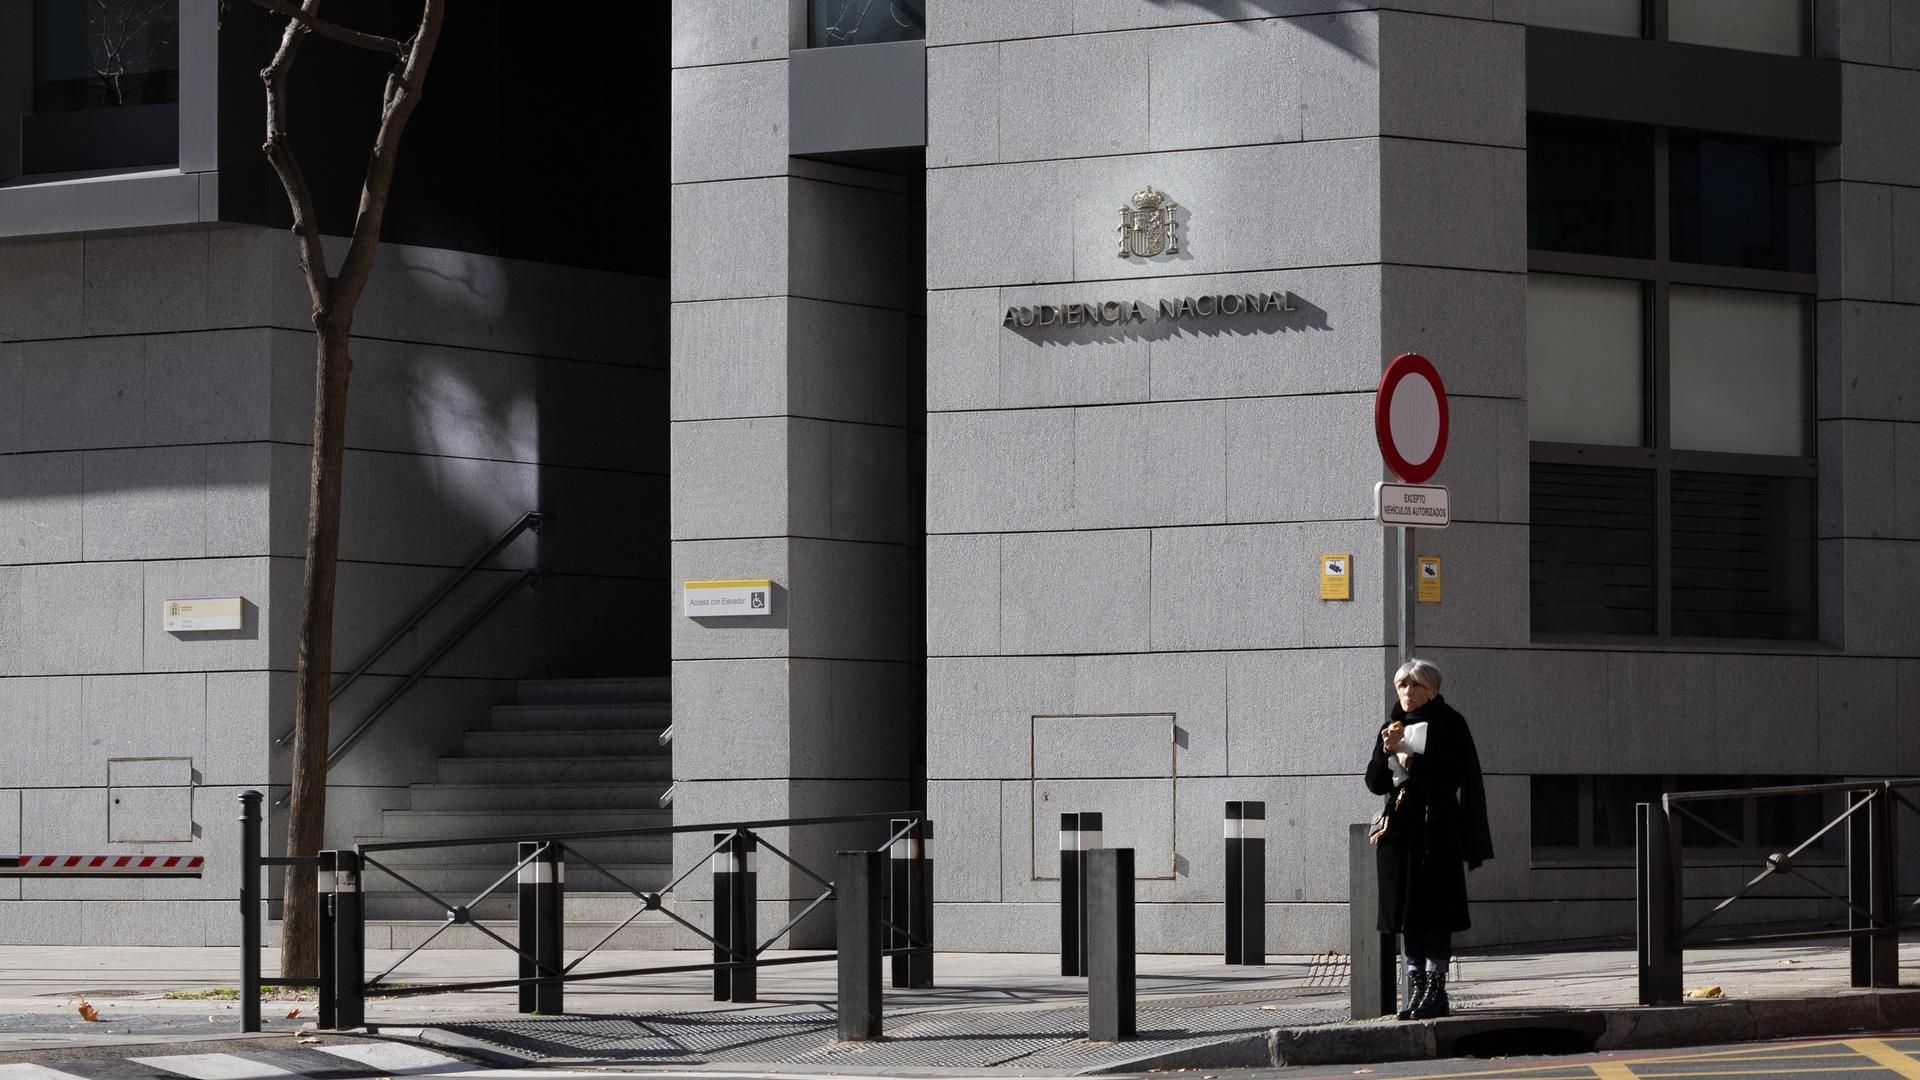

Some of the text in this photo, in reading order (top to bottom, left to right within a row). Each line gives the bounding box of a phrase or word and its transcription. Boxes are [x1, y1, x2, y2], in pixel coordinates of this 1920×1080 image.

[1003, 292, 1296, 327] AUDIENCIA NACIONAL
[1404, 493, 1426, 504] EXCEPTO
[1384, 504, 1446, 517] VEHÍCULOS AUTORIZADOS
[690, 598, 709, 606] Acceso
[721, 597, 746, 605] Elevador
